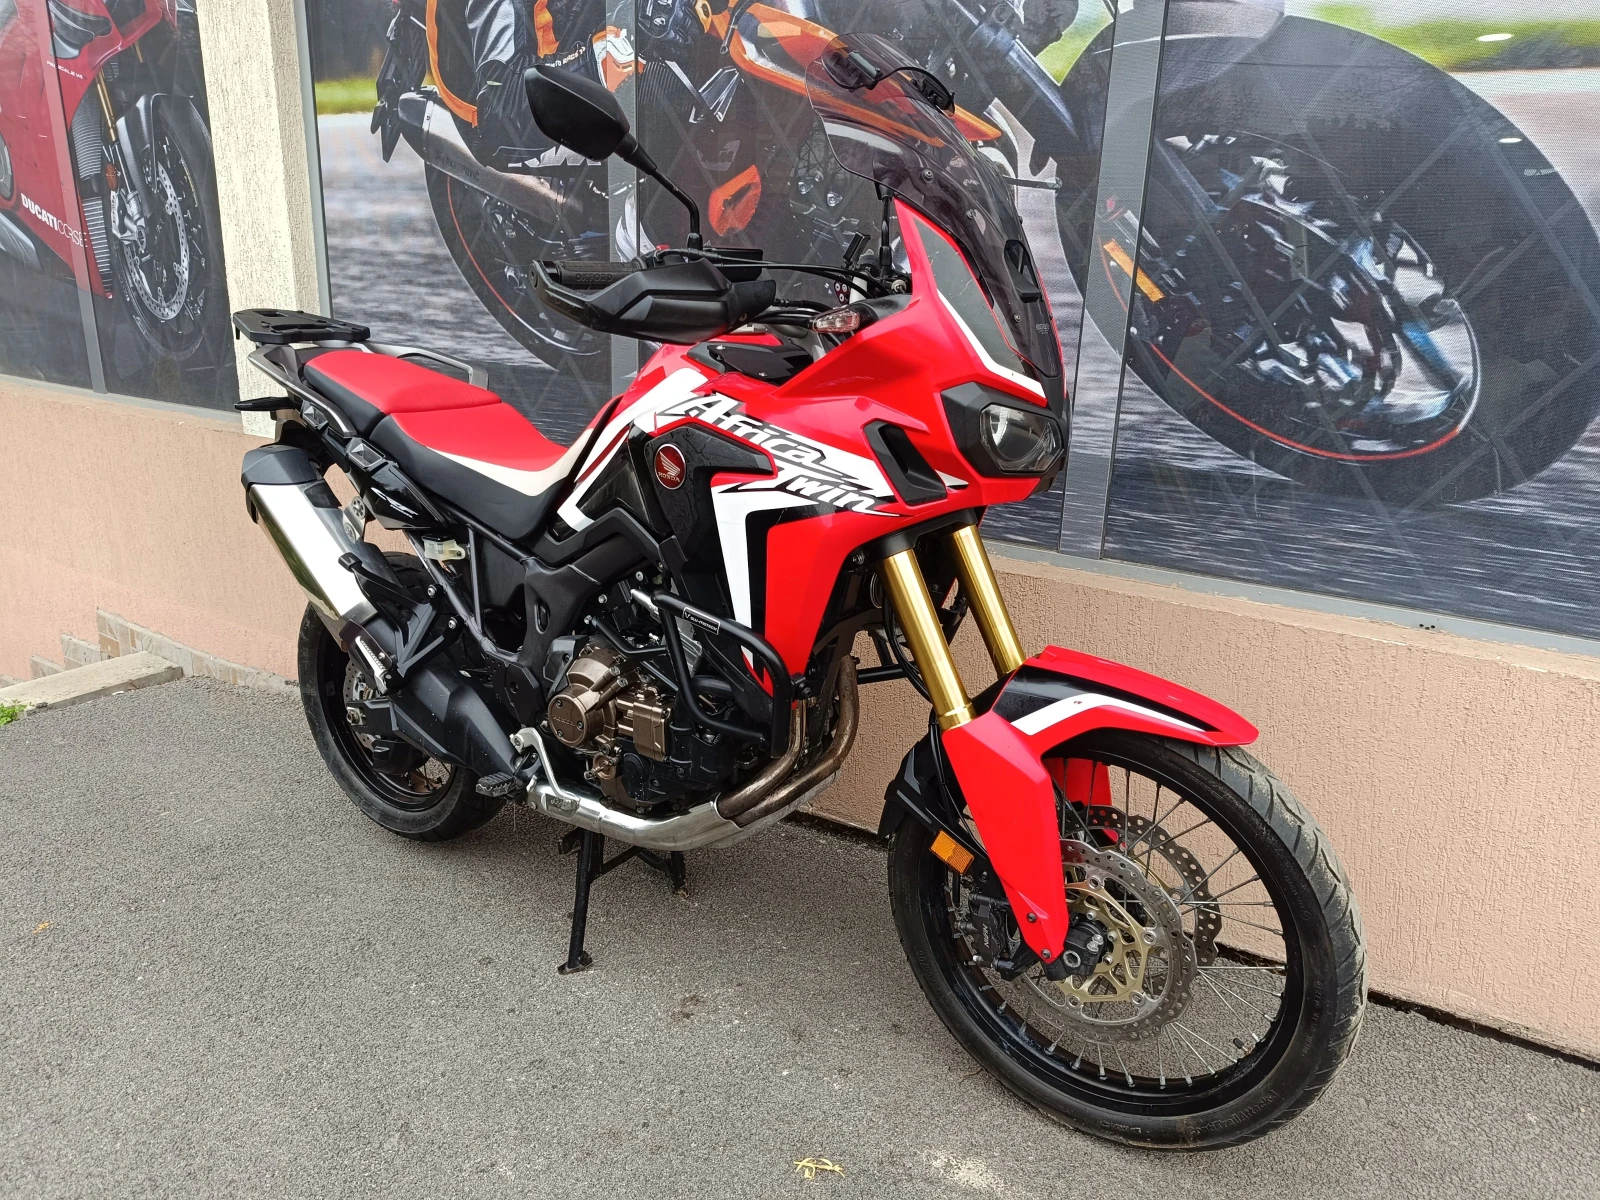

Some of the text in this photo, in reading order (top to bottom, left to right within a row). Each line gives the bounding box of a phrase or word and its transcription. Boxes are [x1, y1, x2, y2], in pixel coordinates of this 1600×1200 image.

[21, 192, 58, 231] DUCATI
[575, 273, 613, 282] OXFORD
[660, 391, 845, 478] Africa
[657, 471, 681, 483] HONDA
[736, 457, 900, 517] Twin
